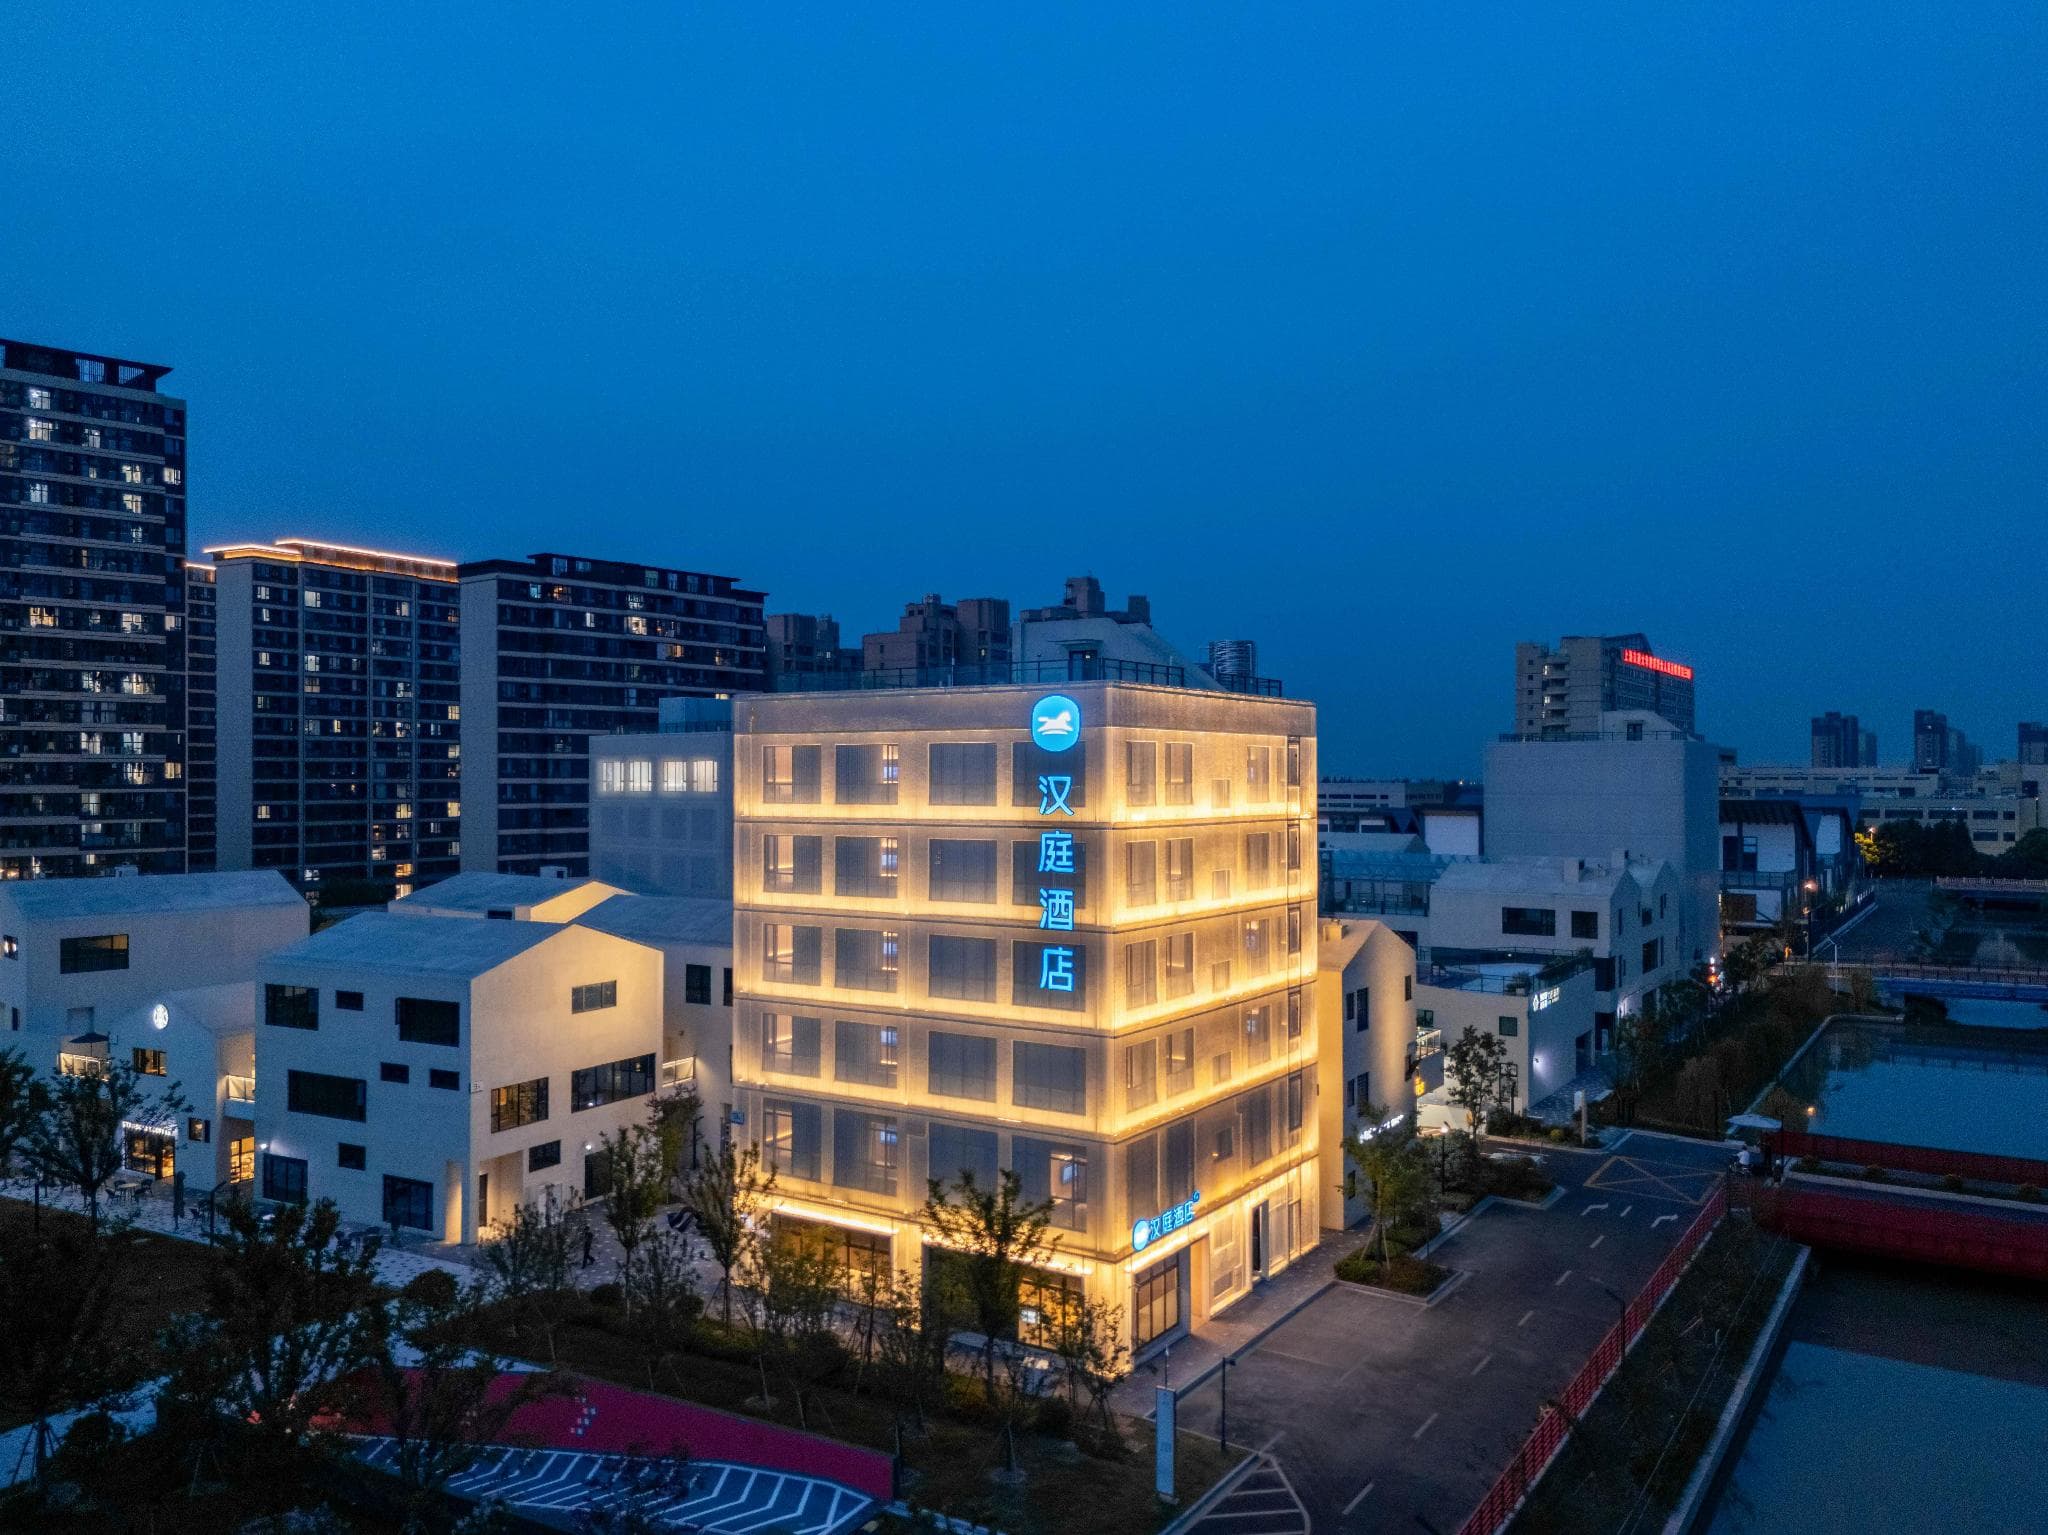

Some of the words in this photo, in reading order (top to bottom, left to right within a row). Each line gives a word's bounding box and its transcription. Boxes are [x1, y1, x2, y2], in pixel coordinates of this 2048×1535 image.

[1038, 774, 1075, 993] 汉庭酒店
[1149, 1200, 1195, 1241] 汉庭酒店
